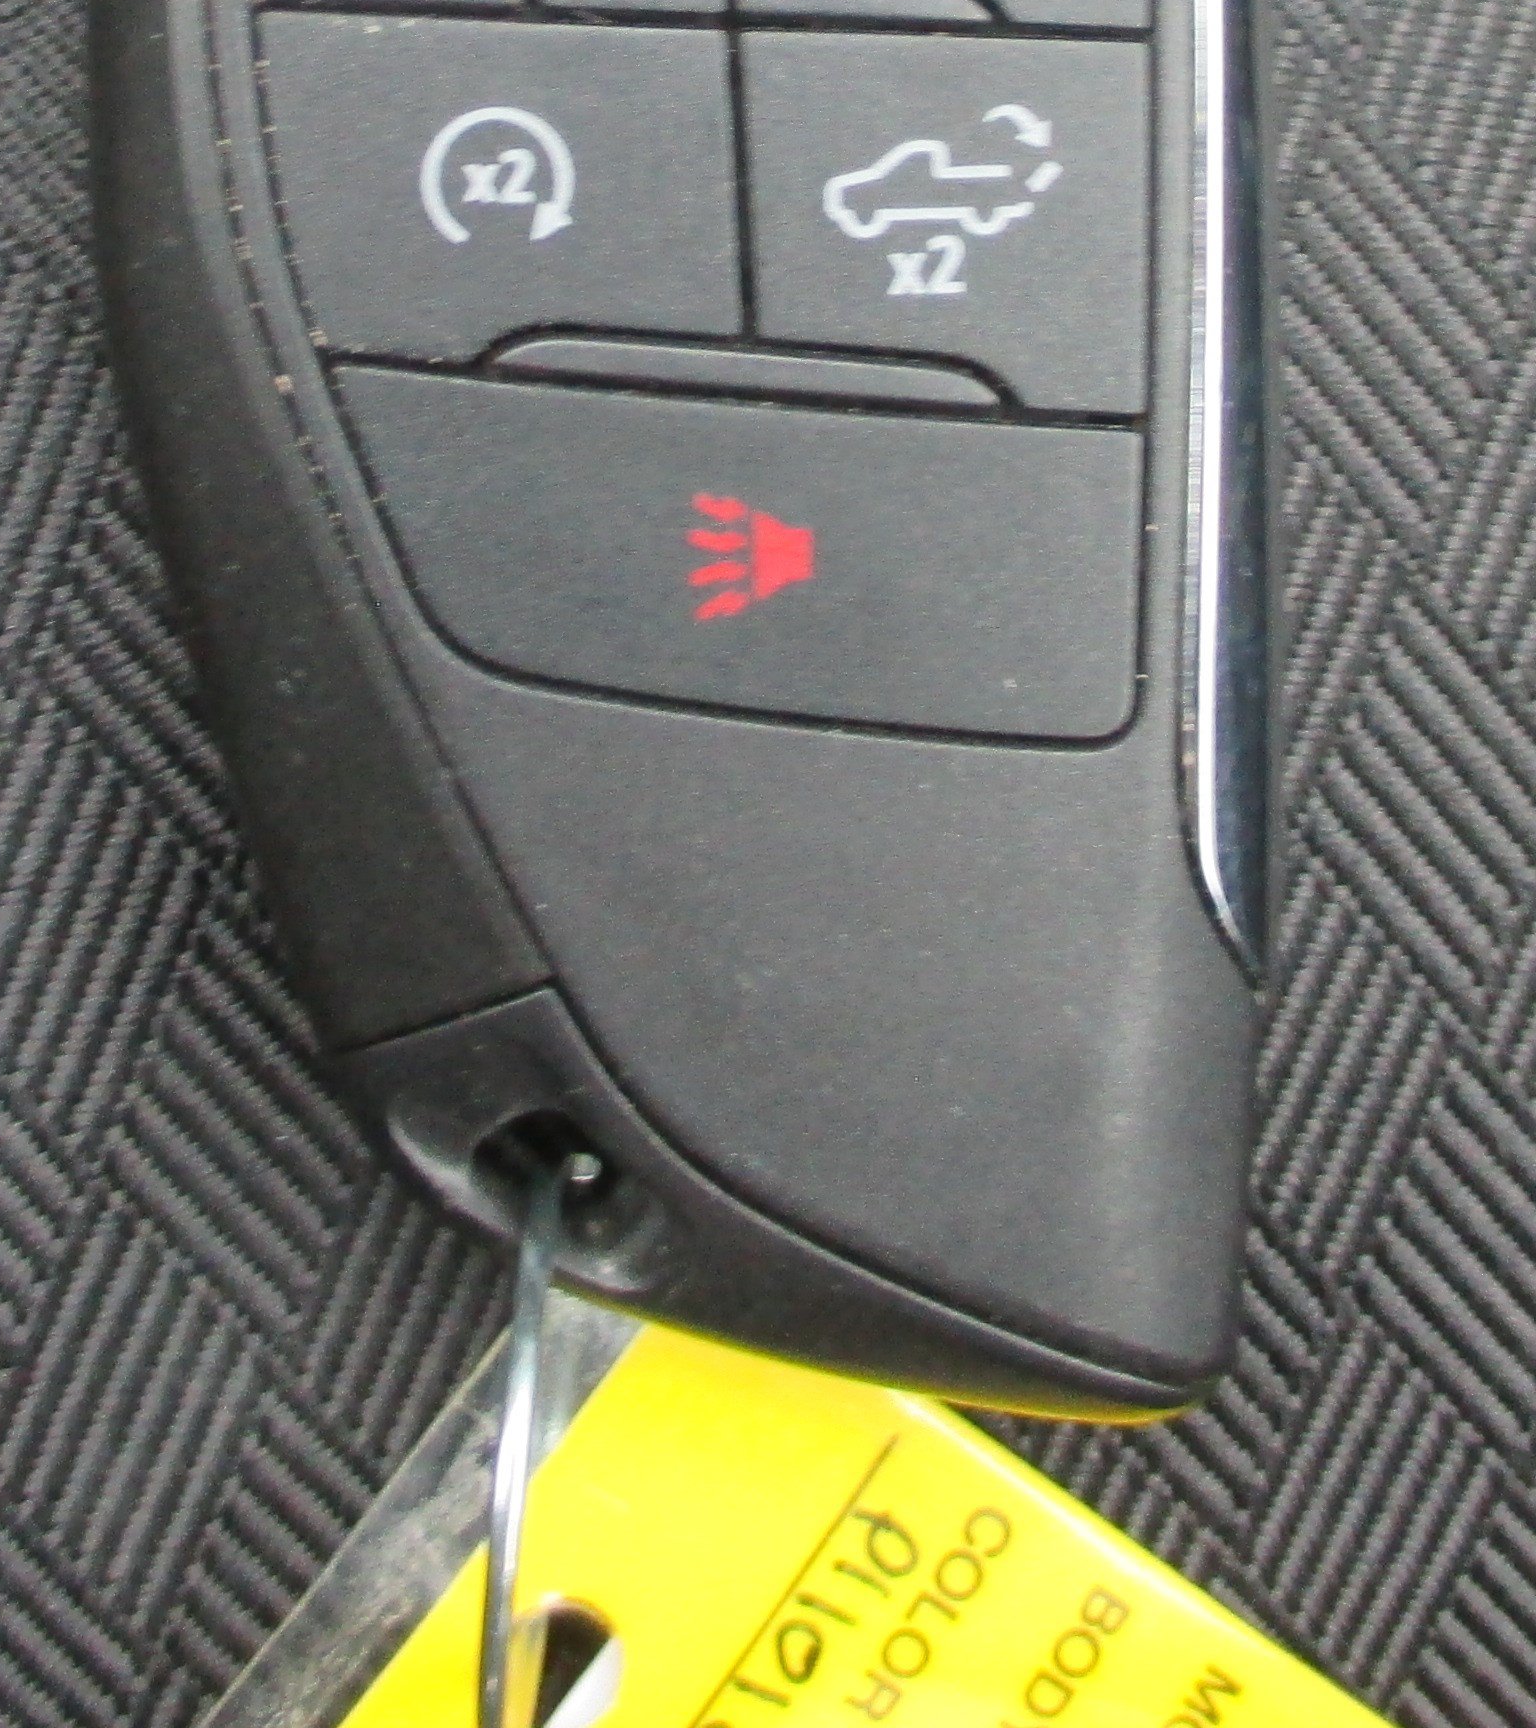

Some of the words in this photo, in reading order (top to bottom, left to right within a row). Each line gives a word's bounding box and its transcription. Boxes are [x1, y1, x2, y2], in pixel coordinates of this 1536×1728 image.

[461, 148, 538, 205] x2
[886, 234, 967, 296] x2
[845, 1506, 1012, 1721] COLOR
[1001, 1584, 1130, 1728] BOD
